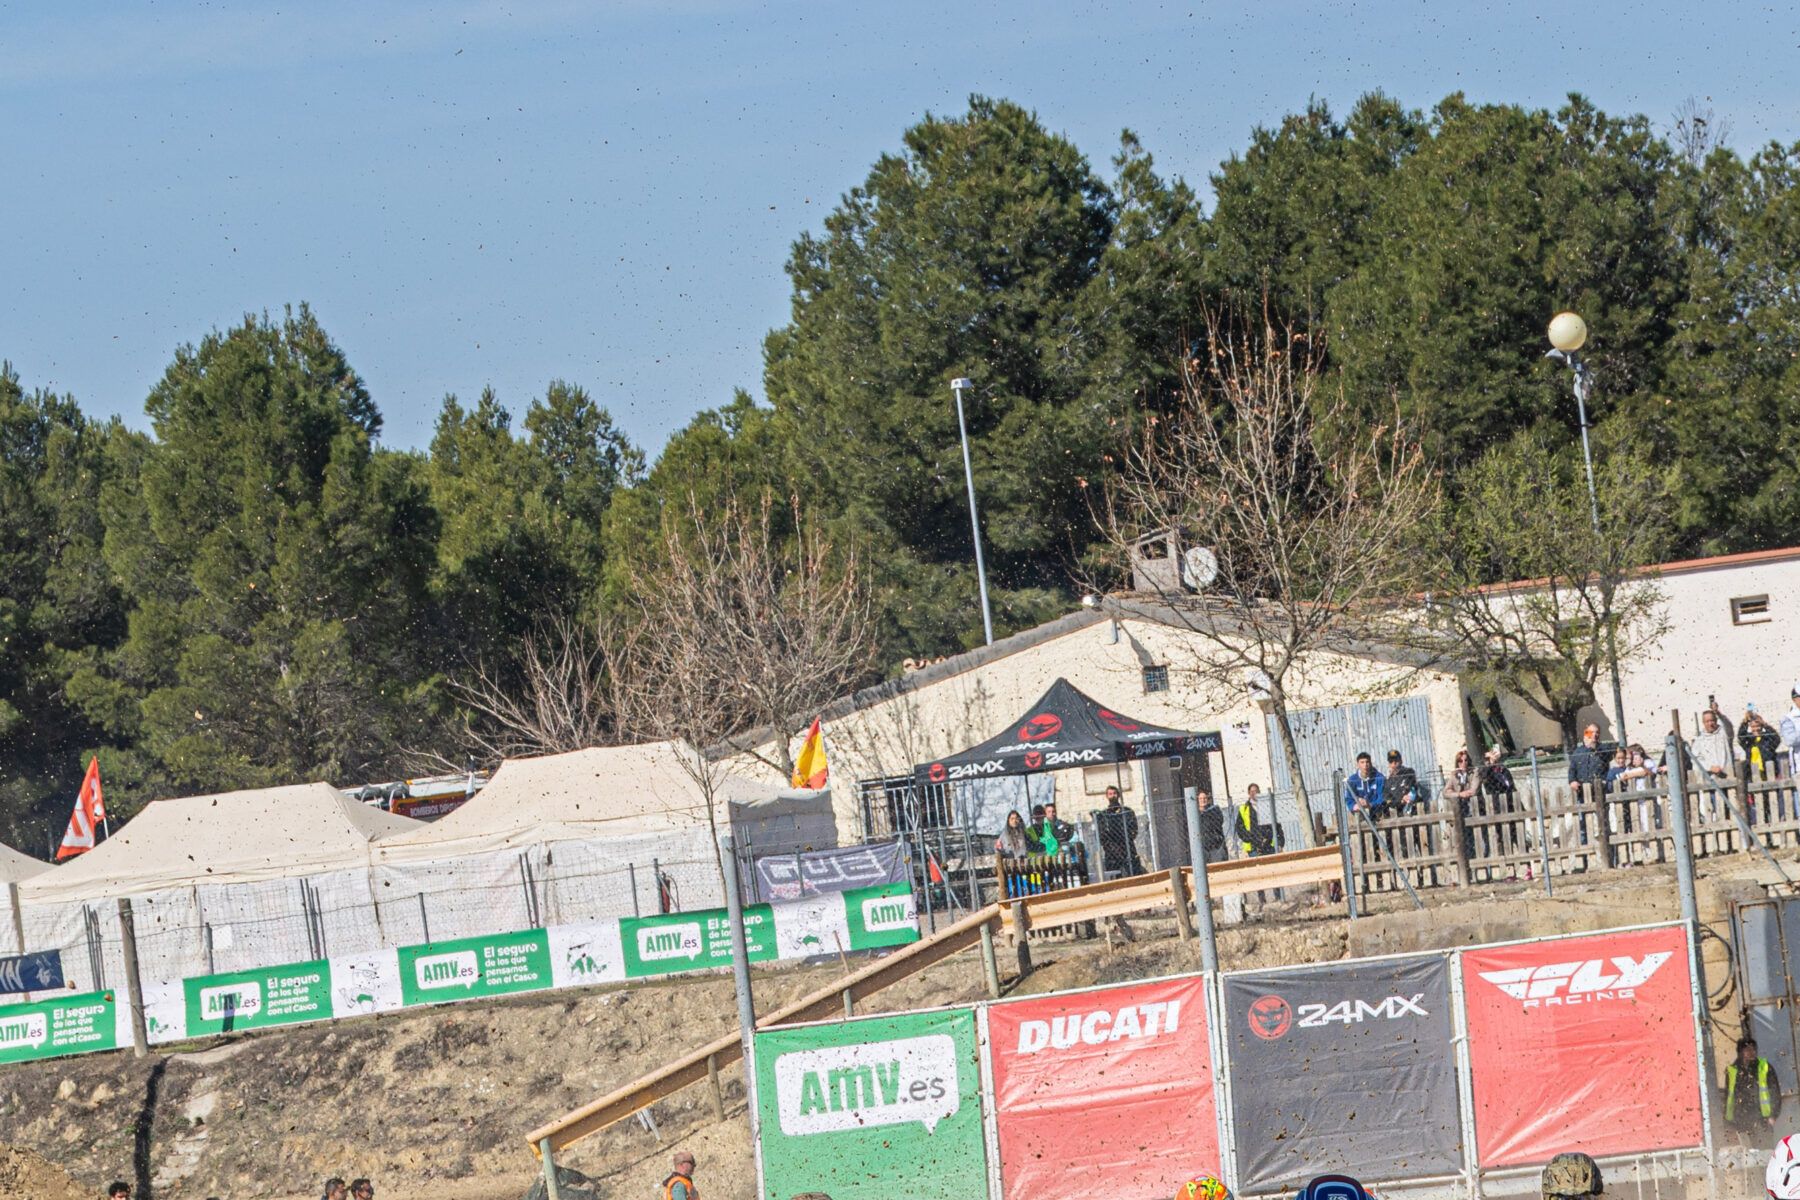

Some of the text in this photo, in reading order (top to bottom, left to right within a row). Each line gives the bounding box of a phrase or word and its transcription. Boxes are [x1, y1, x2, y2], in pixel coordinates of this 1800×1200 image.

[1046, 748, 1103, 766] 24MX
[949, 759, 1006, 779] 24MX
[484, 942, 538, 959] El seguro
[485, 954, 527, 967] de los que
[486, 963, 528, 978] pensamos
[1478, 951, 1674, 1000] FLY
[267, 973, 320, 989] El seguro
[486, 975, 500, 985] con
[513, 972, 538, 983] Casco
[267, 988, 279, 998] de
[293, 985, 309, 998] que
[1524, 989, 1635, 1008] RACING
[53, 1004, 105, 1019] El seguro
[1298, 993, 1429, 1028] 24MX
[53, 1019, 63, 1029] de
[79, 1015, 93, 1028] que
[1017, 1000, 1180, 1054] DUCATI
[53, 1023, 93, 1037] pensamos
[53, 1037, 65, 1047] con
